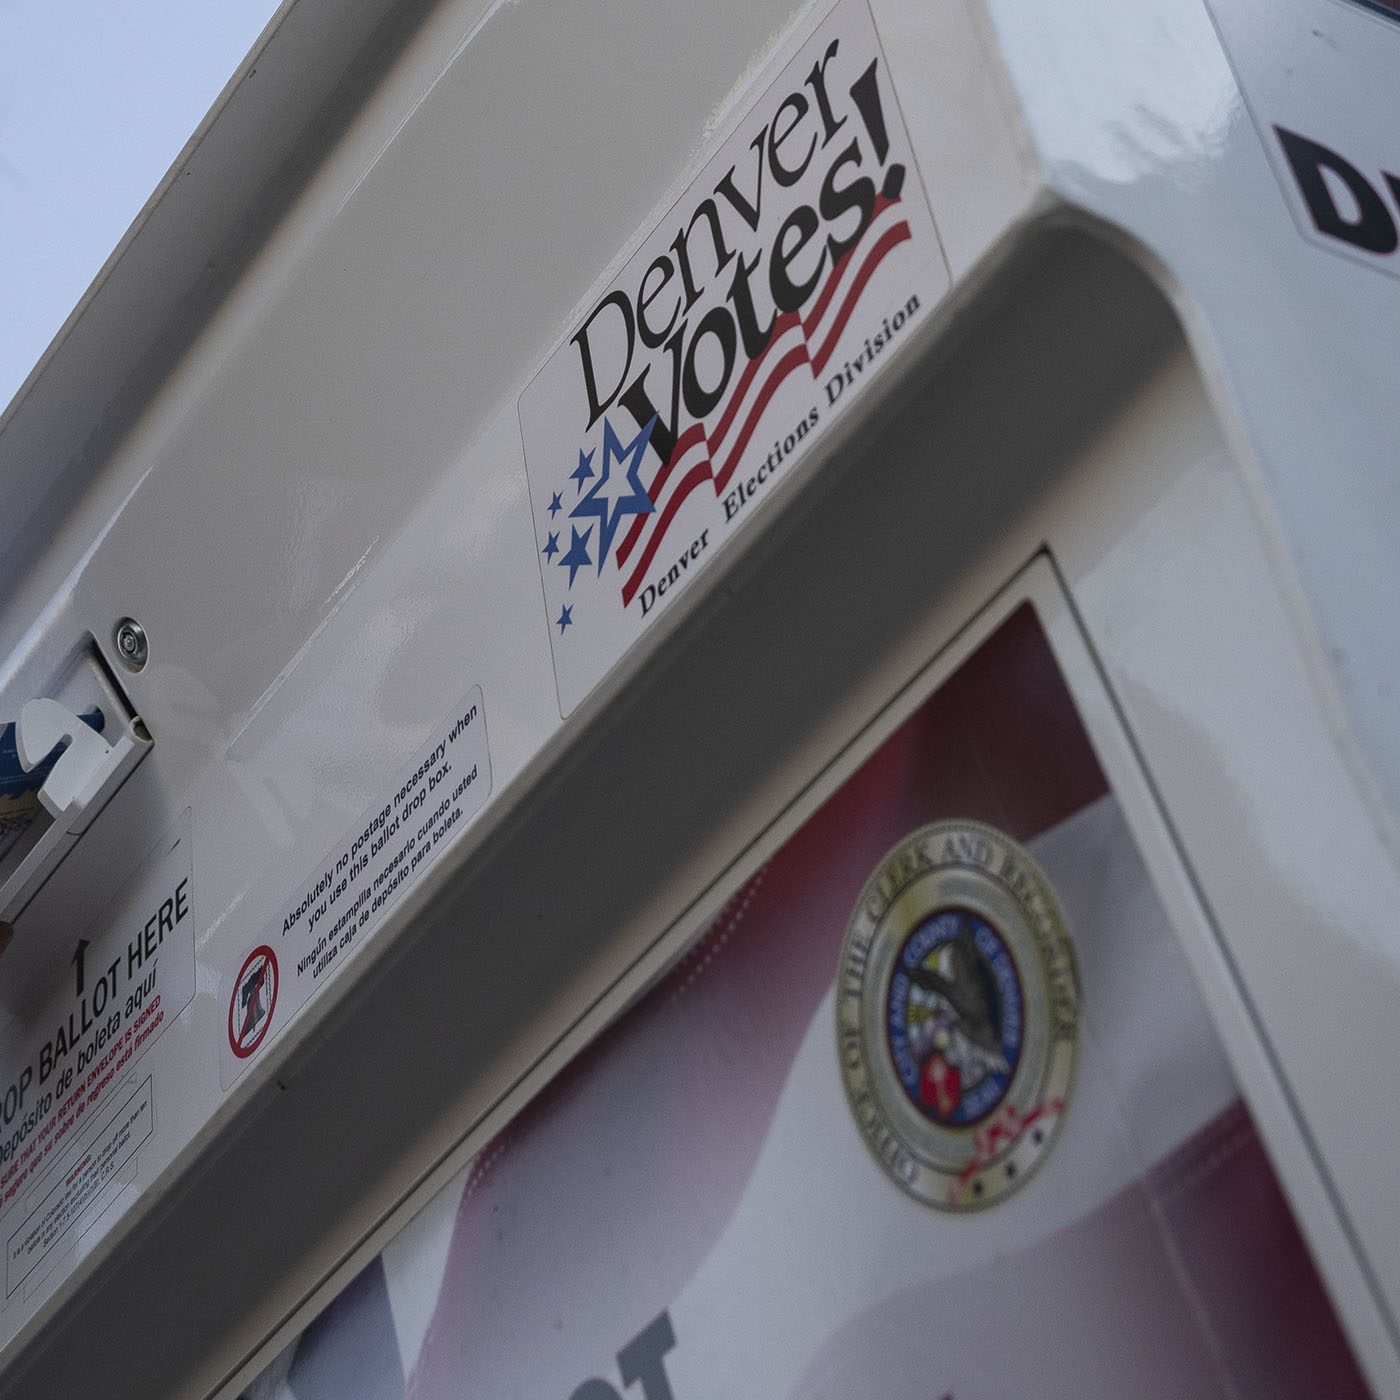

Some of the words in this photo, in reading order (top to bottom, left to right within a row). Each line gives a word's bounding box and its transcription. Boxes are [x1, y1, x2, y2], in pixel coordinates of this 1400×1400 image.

[570, 39, 846, 432] Denver
[618, 57, 905, 468] Votes!
[638, 528, 709, 618] Denver
[721, 406, 819, 524] Elections
[824, 294, 921, 407] Division
[282, 868, 334, 937] Absolutely
[335, 852, 349, 875] no
[351, 804, 392, 861] postage
[393, 739, 447, 809] necessary
[448, 704, 478, 744] when
[297, 936, 327, 978] Ningún
[328, 886, 372, 942] estampilla
[373, 837, 416, 892] necesario
[417, 798, 451, 841] cuando
[452, 763, 478, 802] usted
[308, 900, 327, 934] you
[329, 878, 348, 905] use
[349, 853, 369, 883] this
[370, 815, 400, 859] ballot
[401, 787, 427, 822] drop
[428, 761, 452, 793] box.
[312, 944, 338, 979] utiliza
[339, 923, 358, 950] caja
[358, 909, 370, 928] de
[371, 865, 410, 914] depósito
[410, 840, 432, 873] para
[38, 956, 121, 1087] BALLOT
[127, 877, 189, 981] HERE
[55, 1067, 74, 1100] de
[76, 1010, 121, 1077] boleta
[124, 958, 158, 1020] aquí
